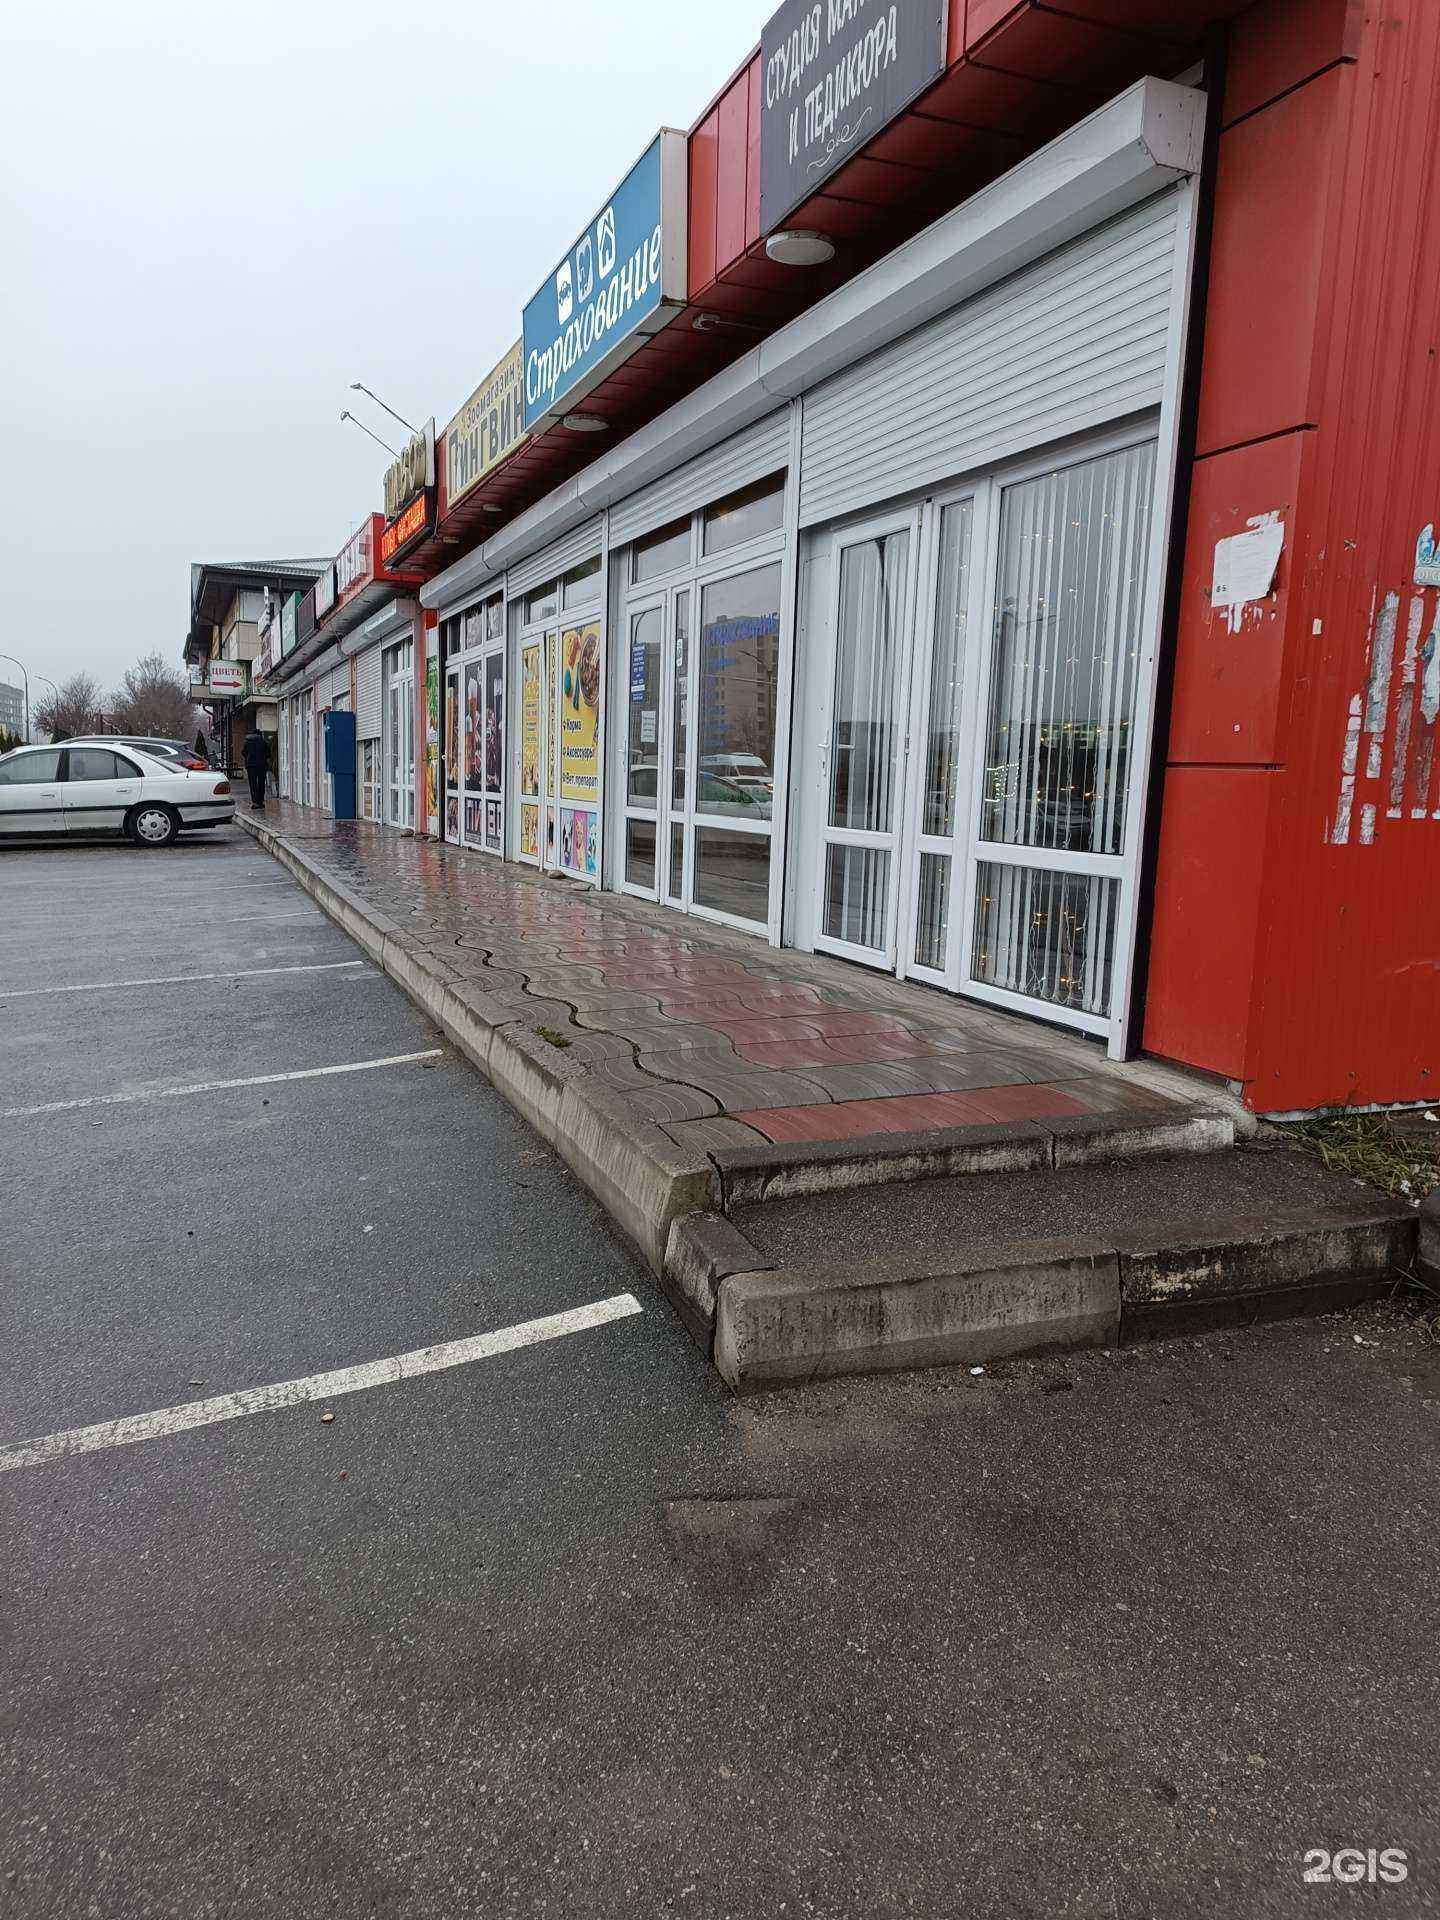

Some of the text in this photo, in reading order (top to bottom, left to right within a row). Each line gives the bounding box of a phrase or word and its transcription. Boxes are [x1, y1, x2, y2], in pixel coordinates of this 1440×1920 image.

[766, 3, 821, 109] СТУДИЯ
[788, 5, 897, 165] И ПЕДИКЮРА
[526, 223, 661, 405] Страхование
[212, 667, 245, 677] ЦВЕТЫ
